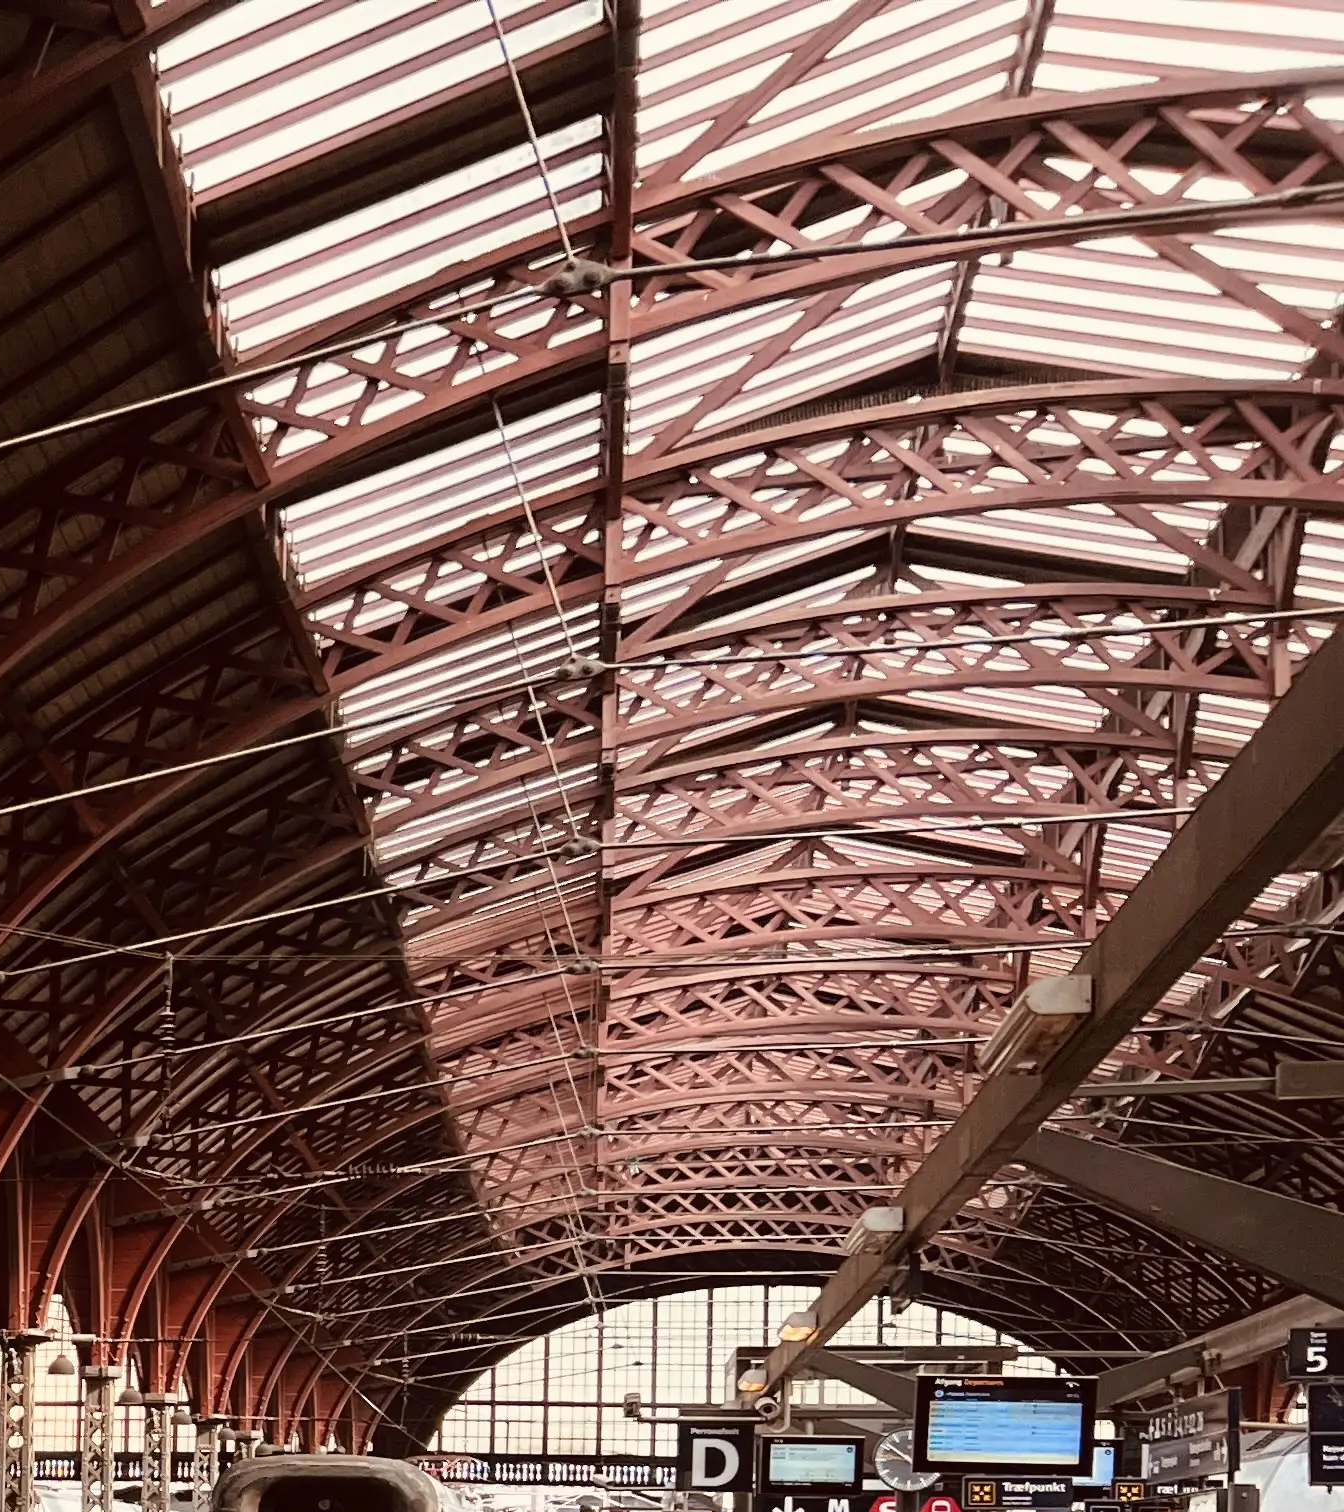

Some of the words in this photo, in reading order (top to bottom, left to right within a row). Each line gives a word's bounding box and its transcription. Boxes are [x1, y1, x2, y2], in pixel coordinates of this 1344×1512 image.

[1306, 1346, 1328, 1373] 5
[692, 1438, 740, 1486] D
[1001, 1481, 1066, 1494] Træfpunkt
